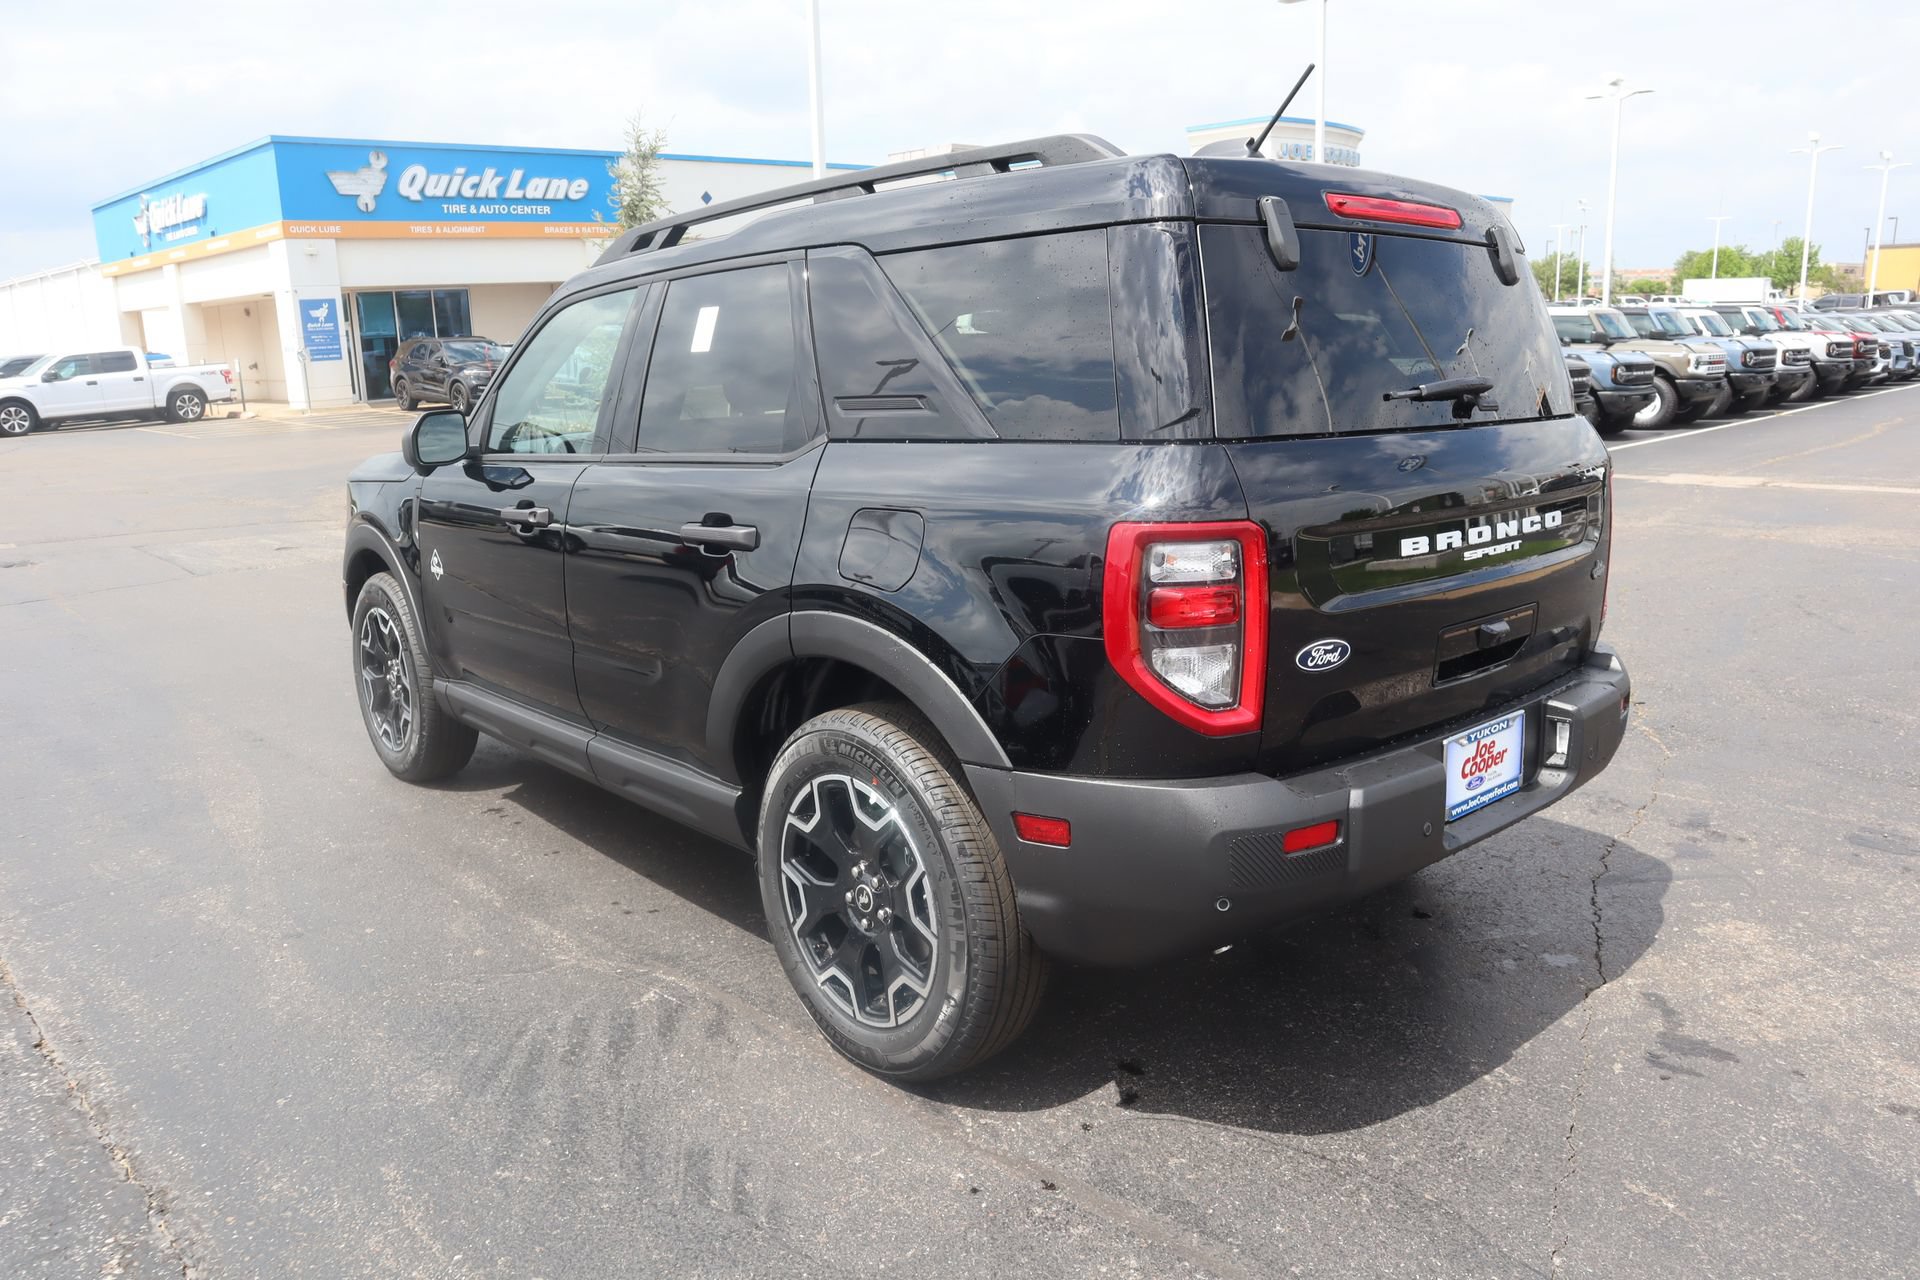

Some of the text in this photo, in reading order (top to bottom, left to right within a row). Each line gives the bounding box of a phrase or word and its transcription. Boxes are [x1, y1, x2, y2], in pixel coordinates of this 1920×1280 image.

[398, 164, 589, 200] Quick Lane
[442, 204, 551, 215] TIRE & AUTO CENTER
[289, 225, 342, 233] QUICK LUBE
[1400, 510, 1562, 557] BRONCO
[1463, 540, 1523, 561] SPORT
[1307, 644, 1342, 667] Ford
[1470, 720, 1508, 741] YUKON
[1472, 740, 1496, 762] Joe
[839, 743, 904, 796] MICHELIN
[1461, 748, 1508, 779] Cooper
[1451, 780, 1518, 816] www.JoeCooperFord.com
